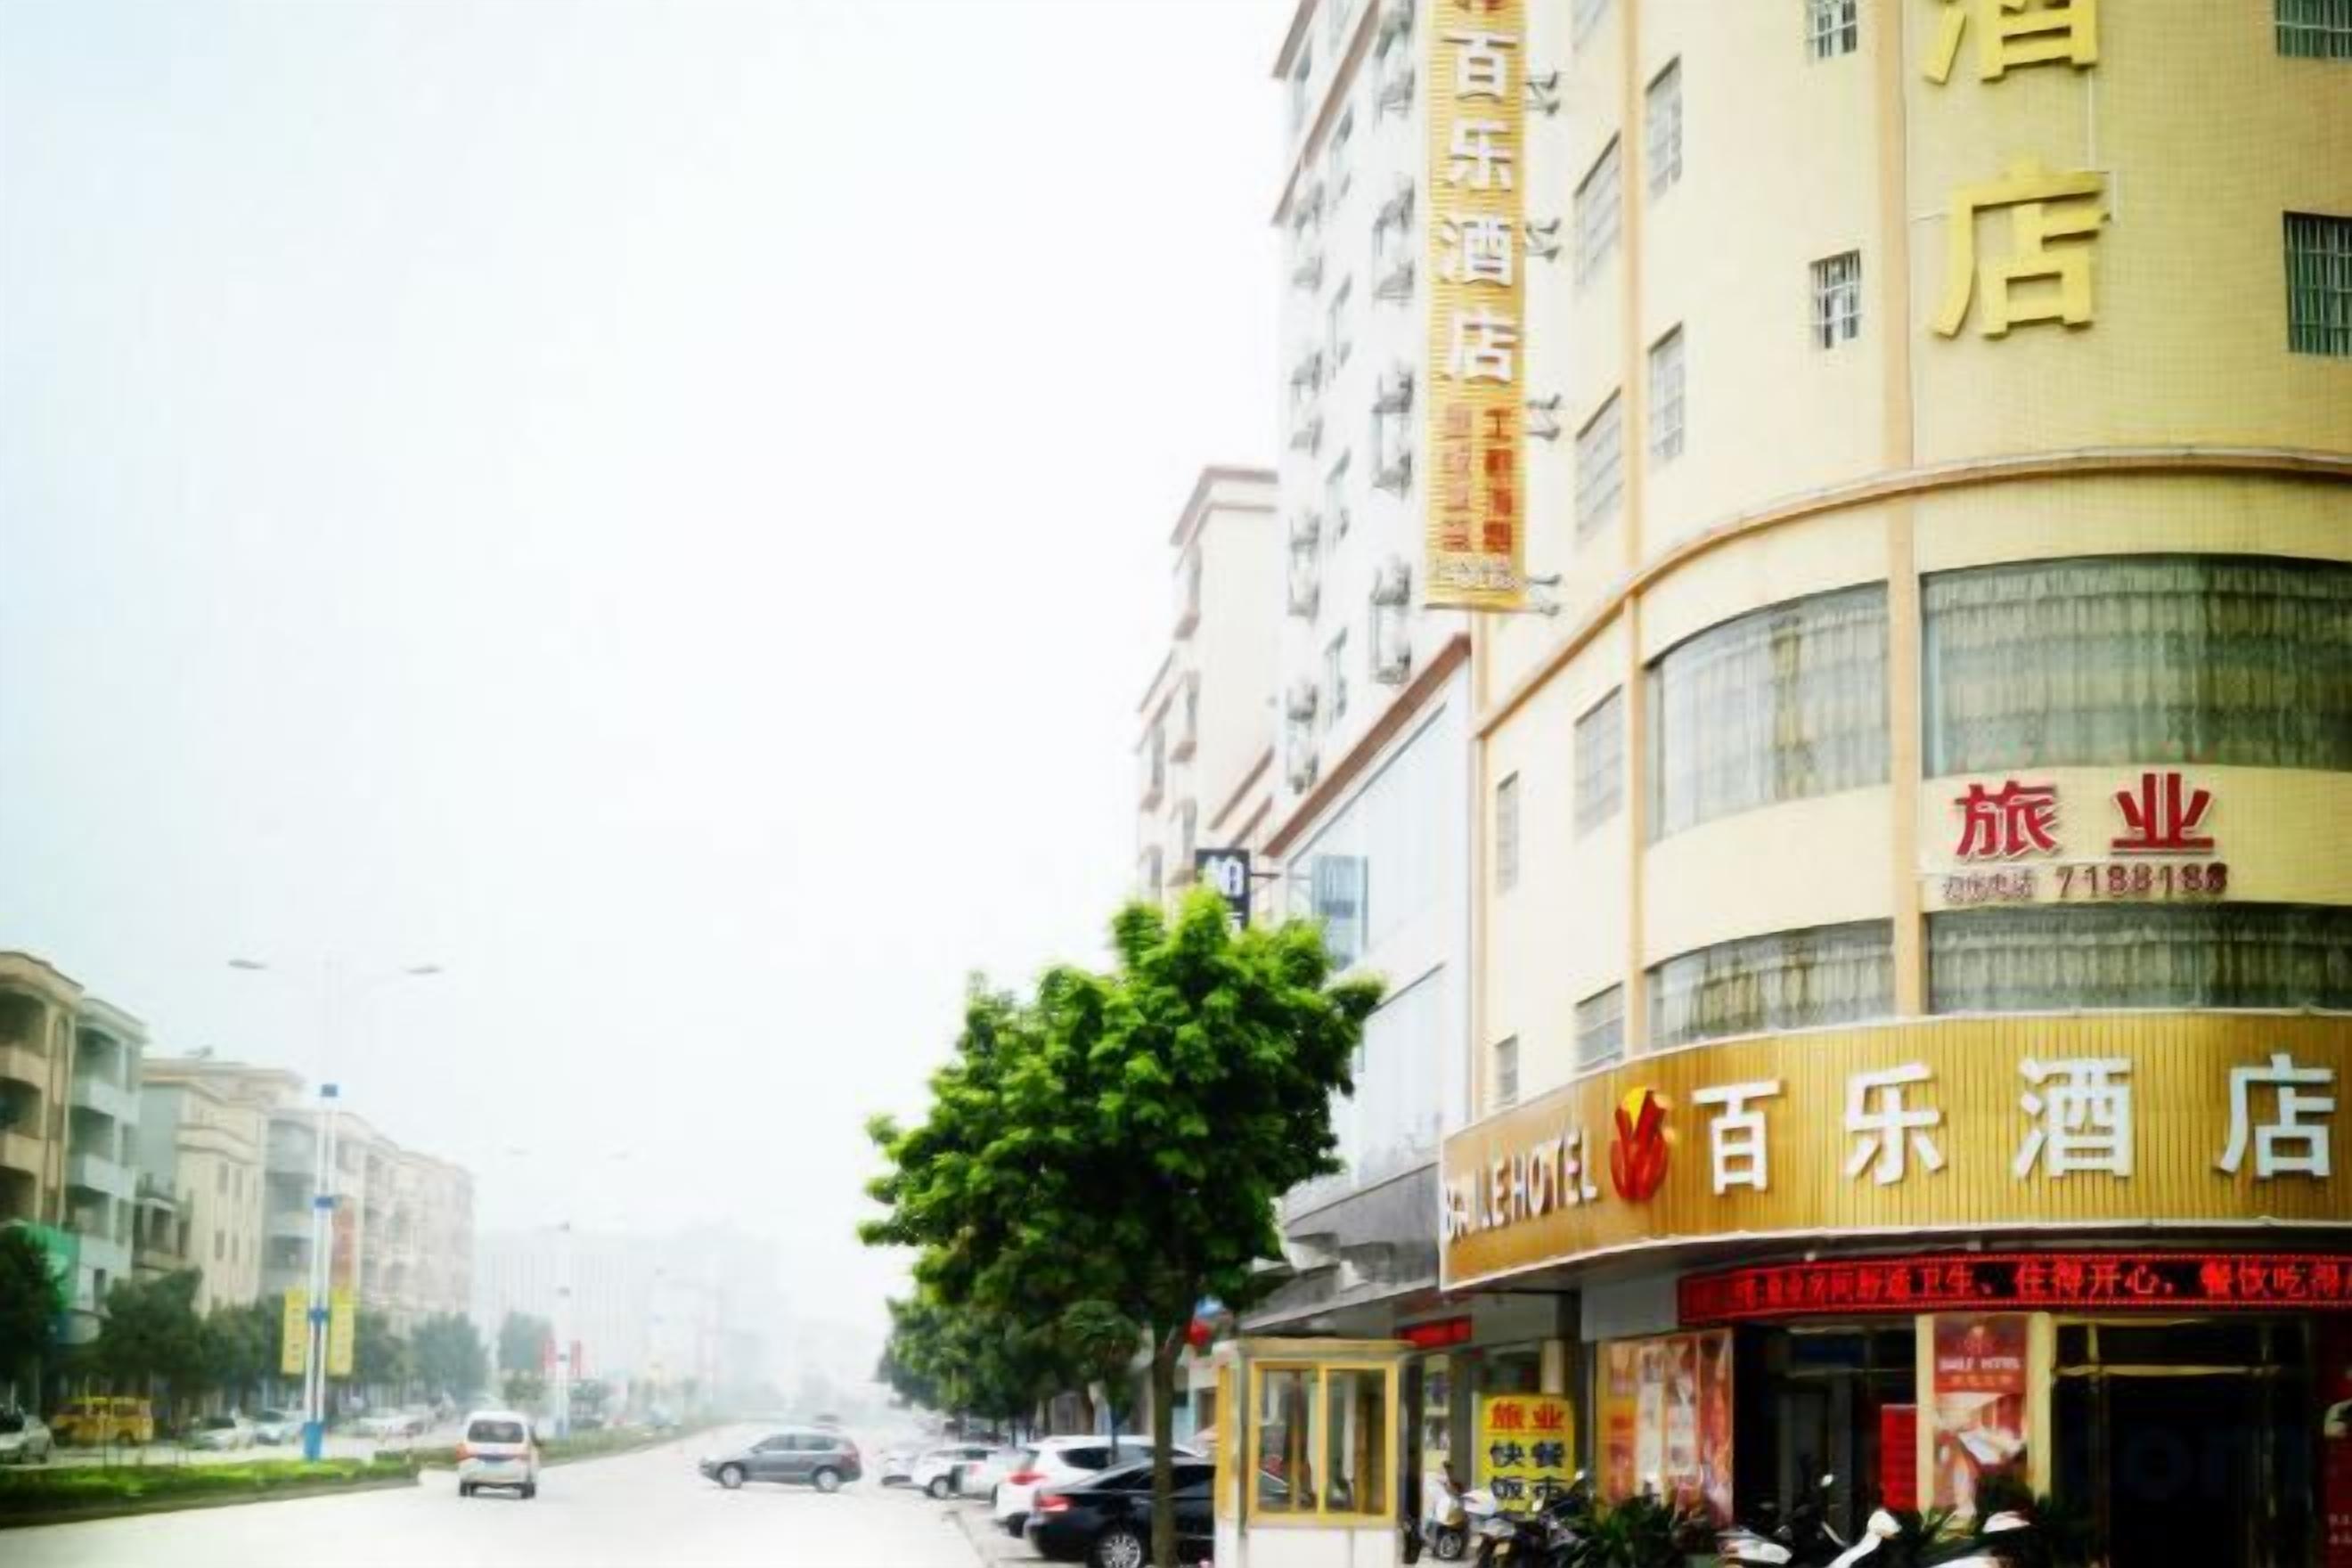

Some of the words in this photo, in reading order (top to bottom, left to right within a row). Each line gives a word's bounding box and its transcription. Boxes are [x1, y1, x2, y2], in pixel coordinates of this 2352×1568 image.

[1437, 31, 1517, 383] 百乐酒店
[1955, 772, 2215, 858] 旅业
[1694, 1053, 2336, 1196] 百乐酒店
